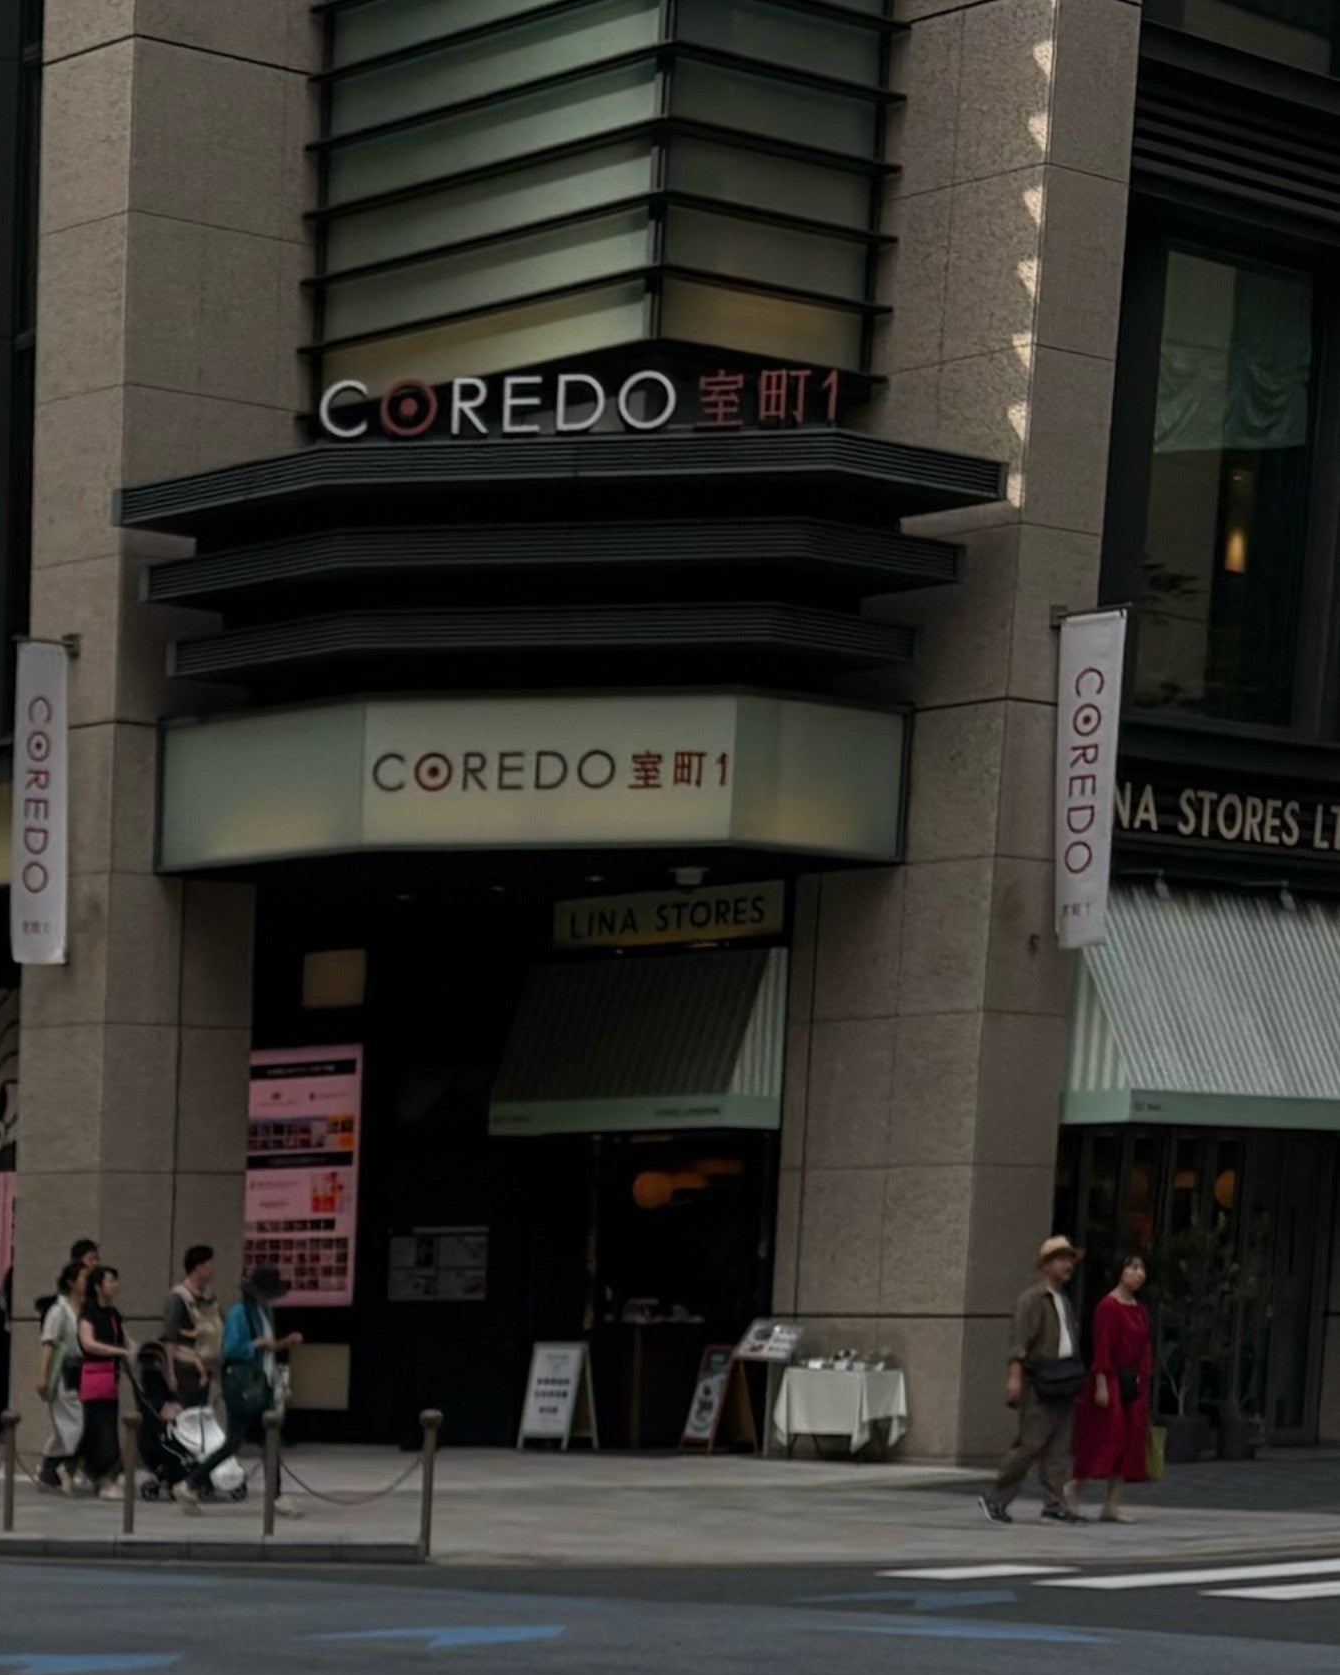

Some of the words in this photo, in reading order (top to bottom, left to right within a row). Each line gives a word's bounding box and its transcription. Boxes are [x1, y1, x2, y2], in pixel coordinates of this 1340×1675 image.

[320, 370, 677, 439] COREDO
[697, 368, 841, 428] 室町1
[22, 696, 53, 894] COREDO
[372, 750, 617, 792] COREDO
[627, 750, 728, 790] 室町1
[1064, 667, 1105, 874] COREDO
[1177, 788, 1300, 847] STORES
[569, 906, 638, 940] LINA
[655, 896, 765, 933] STORES
